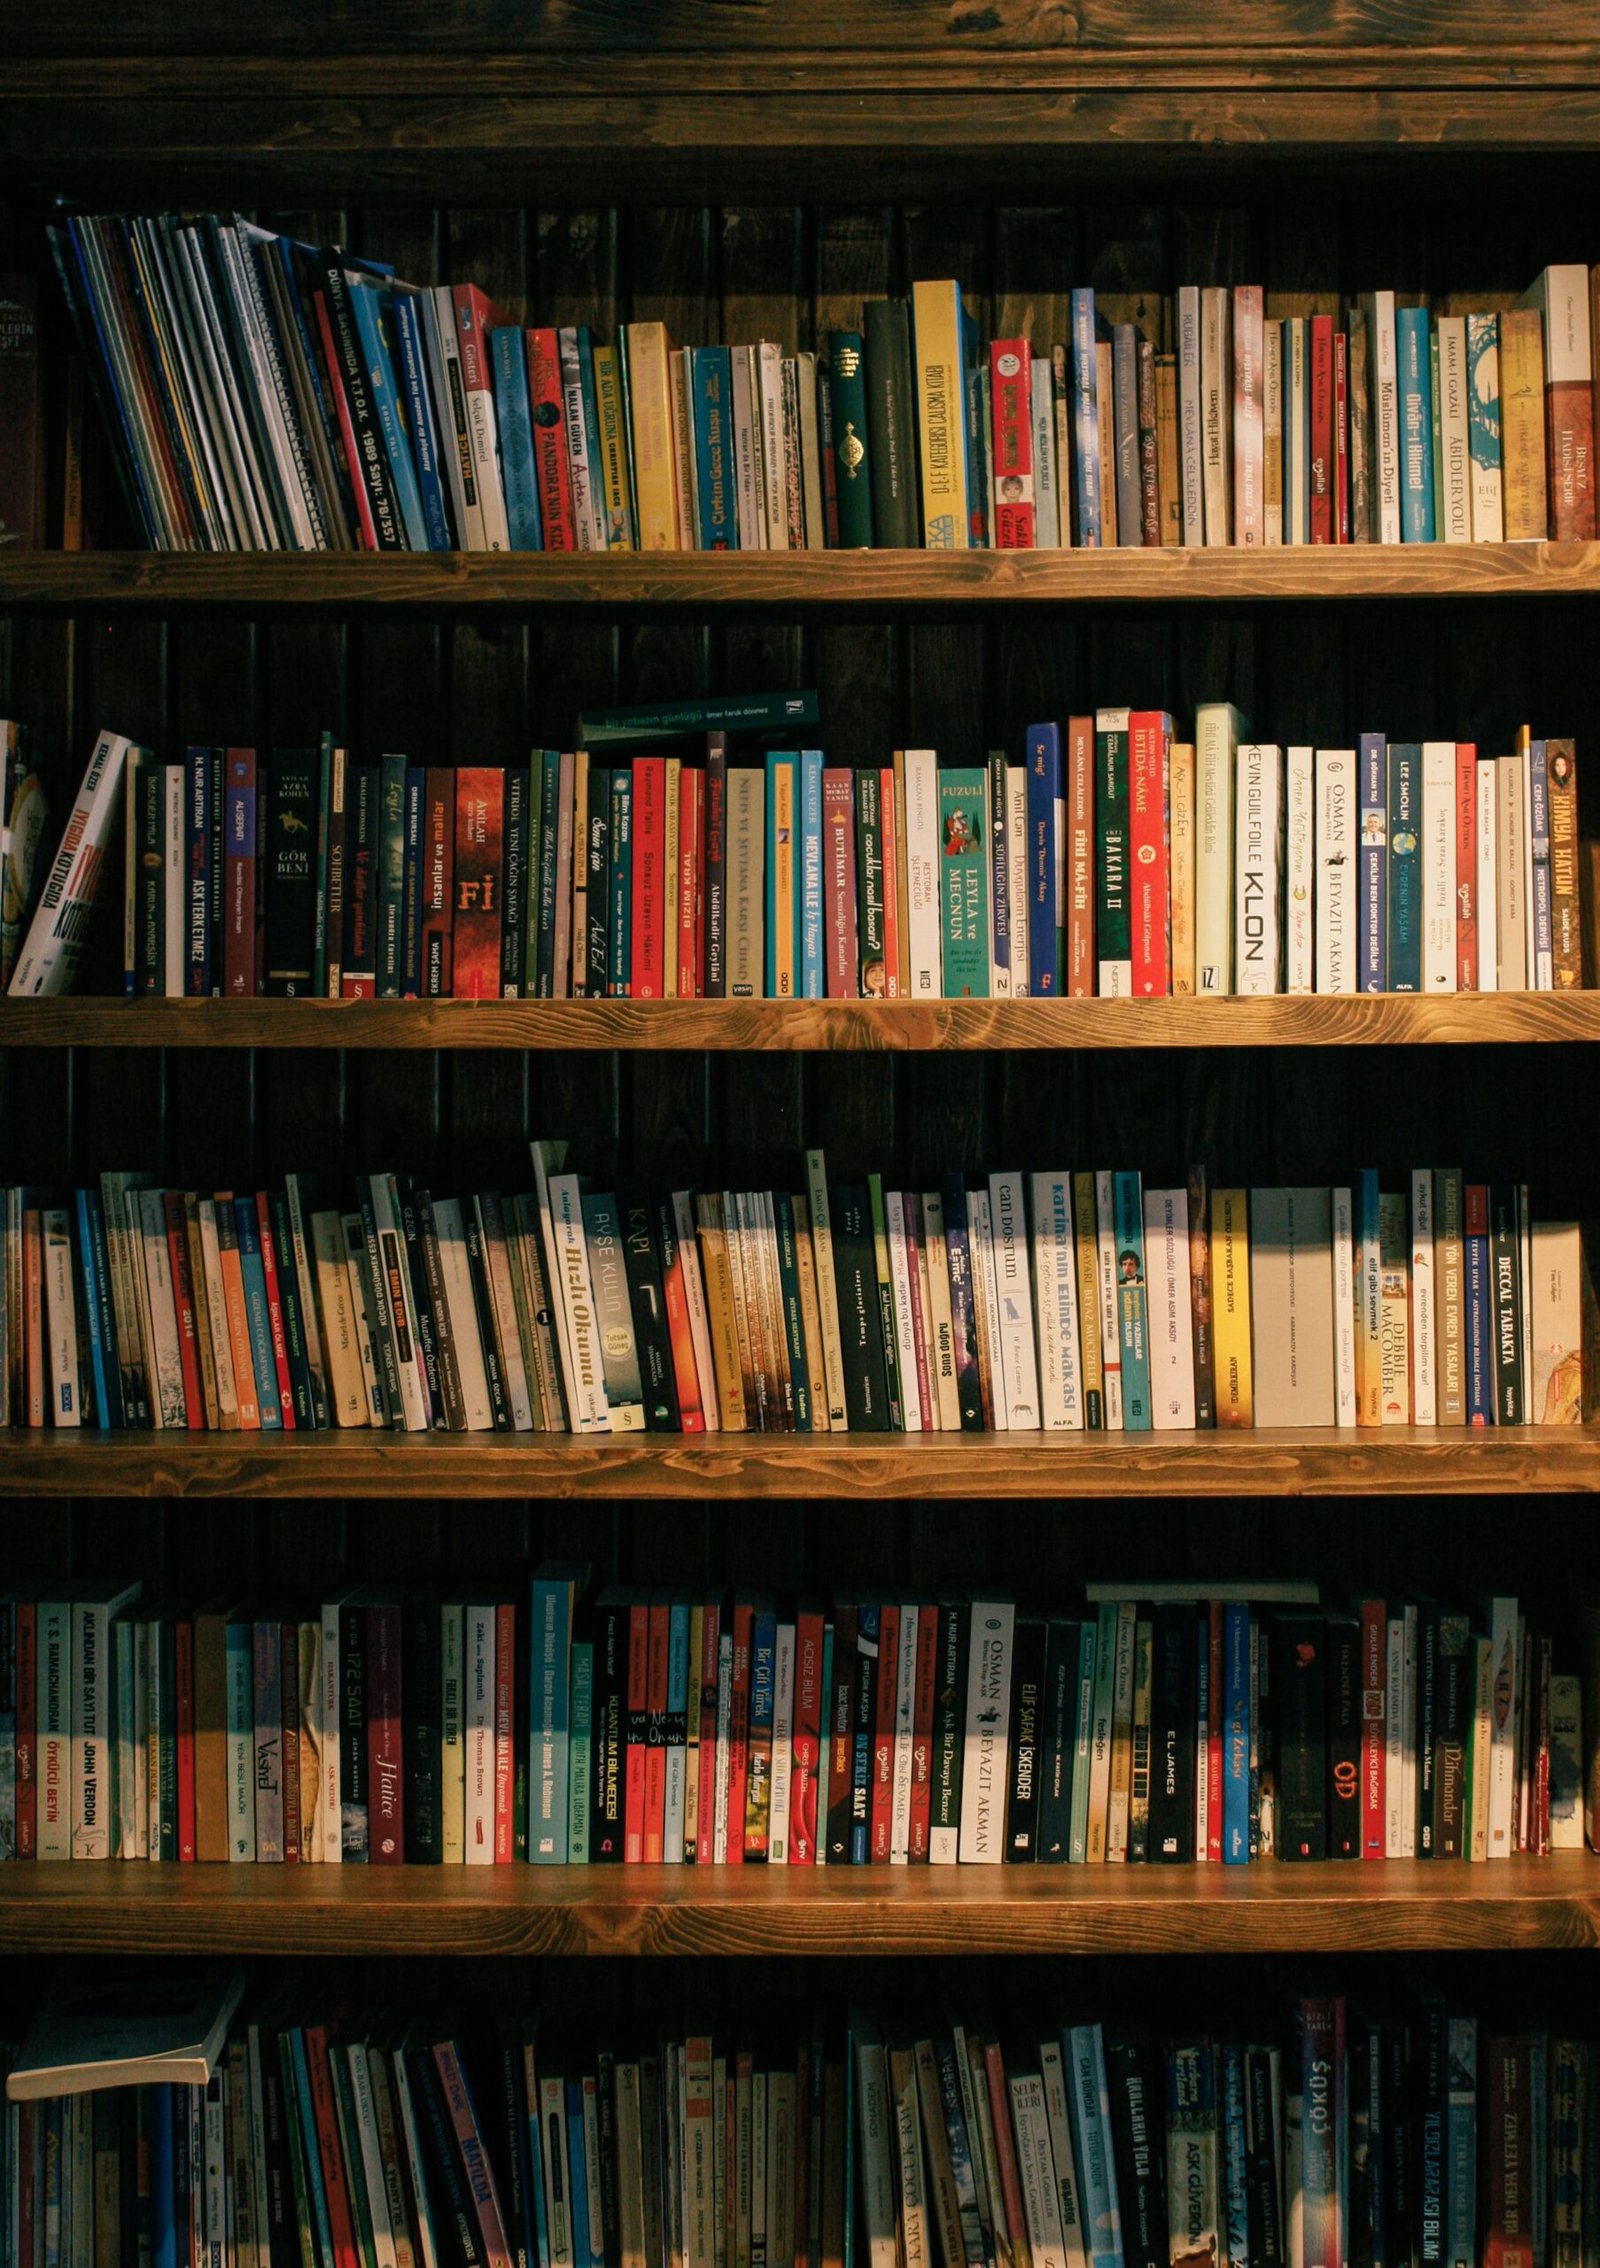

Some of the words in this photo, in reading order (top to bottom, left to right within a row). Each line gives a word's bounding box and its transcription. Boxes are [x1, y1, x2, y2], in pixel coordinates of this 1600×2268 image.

[327, 269, 344, 310] DÜNYA
[333, 313, 359, 376] BASININDA
[465, 343, 479, 384] Gösteri
[599, 360, 611, 377] BİR
[568, 390, 579, 421] NALAN
[601, 380, 613, 399] ADA
[472, 397, 484, 425] Selçuk
[603, 401, 617, 441] UĞRUNA
[362, 430, 378, 462] 1989
[476, 428, 487, 463] Demirel
[572, 424, 583, 456] GÜVEN
[608, 443, 619, 485] CHRISTIAN
[708, 447, 723, 479] Gece
[1380, 467, 1395, 504] Diyeti
[377, 498, 396, 543] 78/357
[1451, 497, 1465, 535] YOLU
[92, 743, 110, 770] KEMAL
[1248, 746, 1260, 785] KEVIN
[1400, 762, 1408, 779] LEE
[86, 771, 100, 792] ÖZER
[194, 768, 204, 788] NUR
[808, 764, 816, 795] KEMAL
[1370, 762, 1379, 788] GÖKHAN
[1534, 784, 1542, 800] CEM
[194, 789, 204, 828] ARTIRAN
[621, 795, 629, 813] Bilim
[808, 798, 817, 824] SEZER
[1332, 784, 1344, 842] OSMAN
[1400, 782, 1409, 820] SMOLIN
[1535, 802, 1544, 832] ÖZÜAK
[1554, 796, 1572, 842] KİMYA
[434, 802, 444, 840] mallar
[1014, 817, 1024, 836] Can
[1248, 789, 1261, 862] GUILFOILE
[278, 852, 308, 862] GÖR
[434, 844, 442, 856] ve
[806, 836, 818, 889] MEVLANA
[834, 828, 846, 887] BUTİMAR
[1106, 836, 1122, 892] BAKARA
[1370, 852, 1380, 884] ÇEKİLİN
[278, 863, 309, 874] BENİ
[1556, 849, 1572, 895] HATUN
[950, 869, 962, 940] MECNUN
[965, 869, 978, 918] LEYLA
[1108, 899, 1121, 909] II
[1329, 873, 1341, 934] BEYAZIT
[1370, 886, 1379, 901] BEN
[1536, 869, 1546, 914] METROPOL
[710, 884, 720, 940] Abdülkadir
[1244, 872, 1263, 960] KLON
[1370, 904, 1380, 940] DOKTOR
[806, 923, 818, 958] Hayatı
[967, 924, 977, 940] ve
[1015, 919, 1028, 962] Enerjisi
[1562, 932, 1570, 953] KUDS
[1370, 943, 1380, 971] DEĞİLİM!
[430, 966, 438, 993] EKREM
[1418, 1184, 1428, 1208] aykut
[561, 1189, 576, 1244] Anlayarak
[1445, 1245, 1458, 1264] YÖN
[565, 1248, 585, 1300] Hızlı
[1368, 1276, 1377, 1294] gibi
[1446, 1268, 1457, 1300] VEREN
[1498, 1256, 1512, 1302] DECCAL
[898, 1280, 908, 1305] kadar
[1084, 1290, 1095, 1321] BEYAZ
[1420, 1288, 1429, 1329] evrenden
[182, 1309, 193, 1337] 2014
[900, 1307, 909, 1320] bu
[1168, 1320, 1177, 1342] AKSOY
[1446, 1305, 1458, 1338] EVREN
[420, 1314, 434, 1352] Muzaffer
[573, 1305, 594, 1386] Okuma
[900, 1326, 911, 1350] dünya
[1124, 1322, 1132, 1346] OLSUN
[1134, 1321, 1142, 1360] YAZIKLAR
[1382, 1305, 1394, 1396] MACOMBER
[1394, 1322, 1405, 1378] DEBBIE
[1420, 1332, 1430, 1366] torpilim
[1500, 1308, 1514, 1364] TABAKTA
[425, 1354, 439, 1392] Özdemir
[942, 1352, 952, 1376] Sona
[1446, 1342, 1458, 1392] YASALARI
[1506, 1386, 1515, 1417] hayykitap
[84, 1612, 95, 1664] AKLINDAN
[758, 1648, 771, 1663] Bir
[347, 1652, 361, 1679] 172
[802, 1640, 814, 1676] ACISIZ
[946, 1644, 956, 1684] ARTIRAN
[989, 1640, 1003, 1700] OSMAN
[48, 1643, 59, 1731] RAMACHANDRAN
[84, 1687, 95, 1713] SAYI
[754, 1688, 771, 1717] Yürek
[348, 1685, 362, 1728] SAAT
[607, 1695, 619, 1754] KUANTUM
[84, 1716, 95, 1734] TUT
[497, 1710, 508, 1754] MEVLANA
[944, 1732, 954, 1748] Bir
[1095, 1718, 1106, 1761] fesleğen
[47, 1741, 59, 1784] ÖYKÜCÜ
[84, 1742, 96, 1774] JOHN
[476, 1730, 484, 1765] Thomas
[542, 1743, 552, 1769] James
[979, 1730, 994, 1791] BEYAZIT
[376, 1754, 397, 1818] Hatice
[476, 1769, 484, 1796] Brown
[940, 1750, 952, 1786] Davaya
[1017, 1746, 1035, 1800] İSKENDER
[1166, 1752, 1175, 1794] JAMES
[1334, 1762, 1358, 1800] OD
[84, 1779, 96, 1826] VERDON
[542, 1780, 553, 1818] Robinson
[854, 1788, 866, 1818] SAAT
[940, 1788, 951, 1823] Benzer
[976, 1796, 990, 1853] AKMAN
[1080, 2058, 1091, 2077] CAN
[1082, 2080, 1095, 2118] DÜNDAR
[462, 2138, 492, 2205] MATILDA
